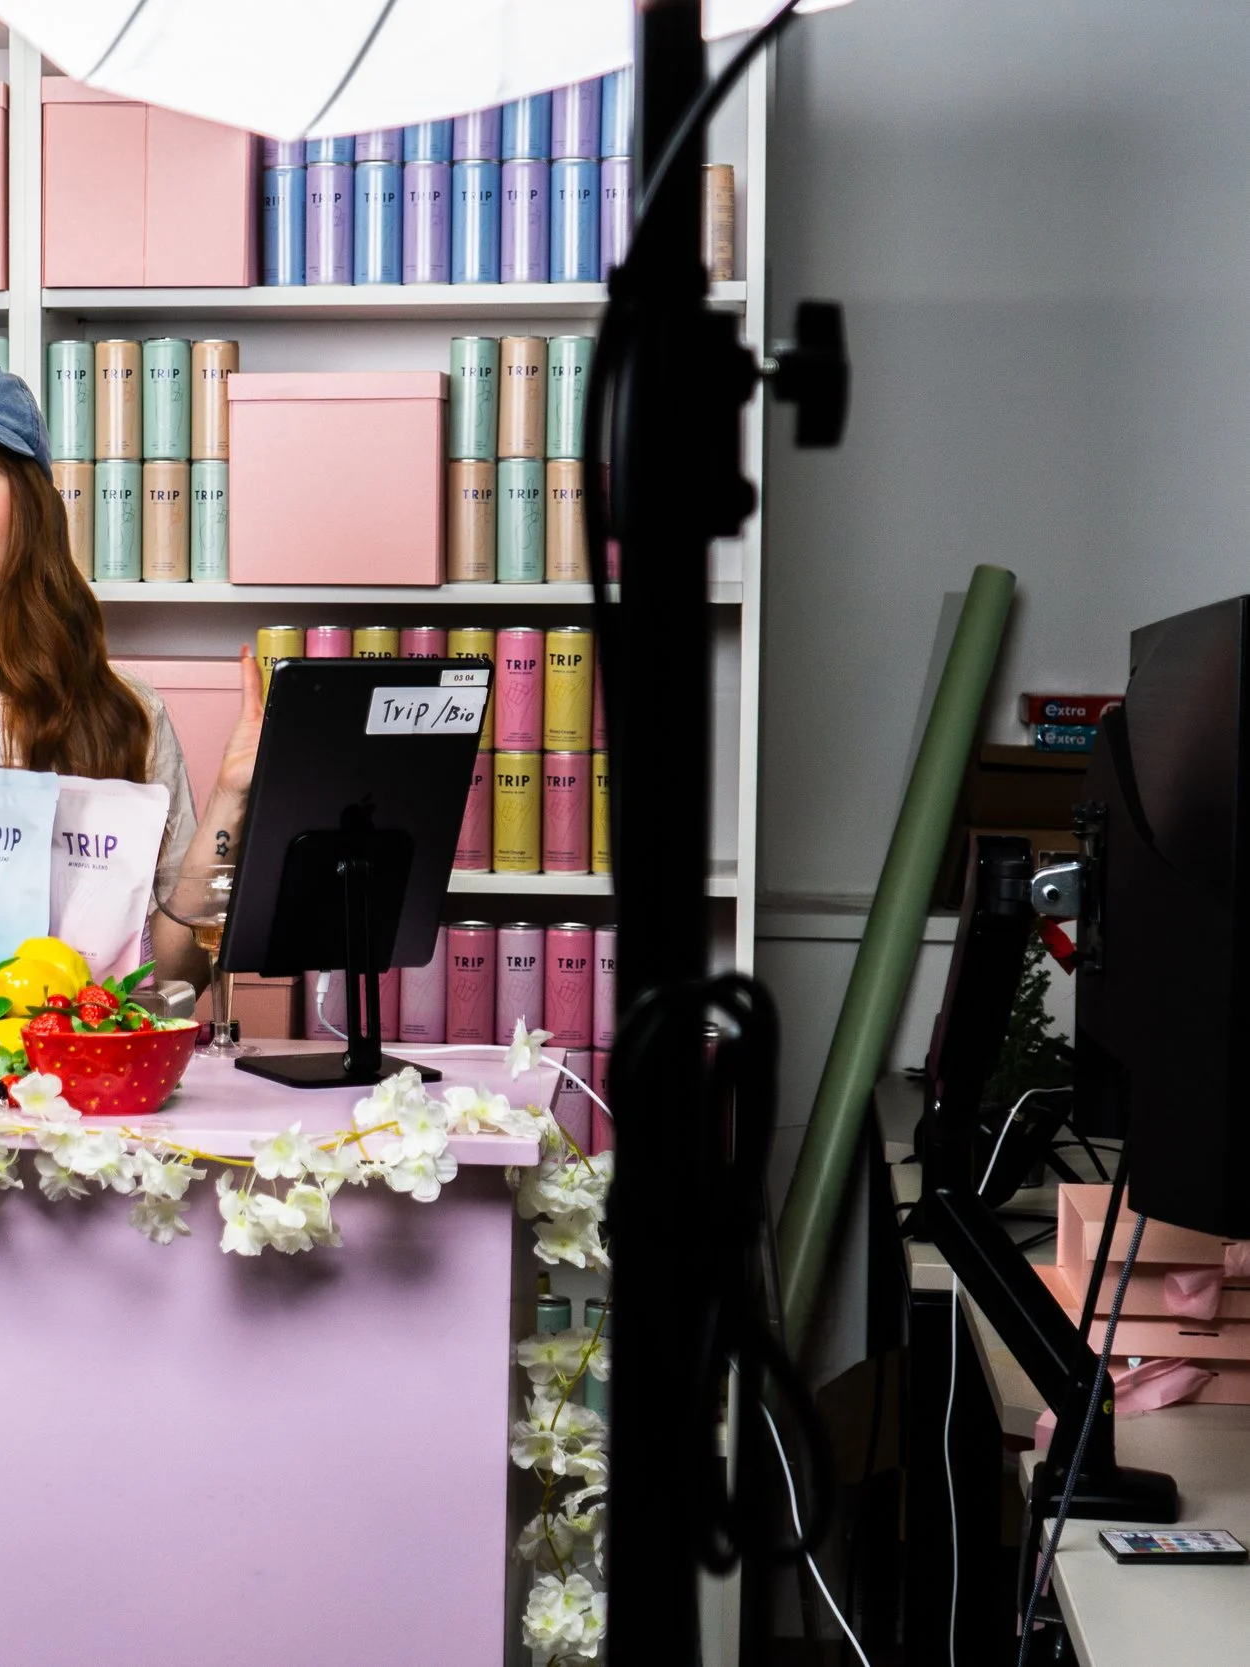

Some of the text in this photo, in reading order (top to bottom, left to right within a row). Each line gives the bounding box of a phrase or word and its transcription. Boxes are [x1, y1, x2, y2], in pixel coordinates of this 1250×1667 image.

[311, 192, 341, 204] TRIP
[364, 192, 395, 203] TRIP
[410, 191, 440, 203] TRIP
[461, 190, 492, 202] TRIP
[507, 189, 538, 201] TRIP
[559, 189, 590, 200] TRIP
[57, 370, 86, 380] TRIP
[103, 368, 132, 379] TRIP
[150, 368, 180, 379] TRIP
[461, 367, 492, 377] TRIP
[507, 366, 539, 376] TRIP
[552, 366, 582, 376] TRIP
[59, 489, 81, 499] RIP
[102, 489, 132, 500] TRIP
[150, 490, 180, 501] TRIP
[195, 490, 223, 500] TRIP
[462, 489, 492, 499] TRIP
[509, 489, 539, 499] TRIP
[552, 489, 583, 499] TRIP
[263, 656, 277, 667] TR
[506, 659, 536, 670] TRIP
[549, 653, 582, 666] TRIP
[1045, 704, 1086, 717] extra
[1045, 732, 1086, 745] extra
[498, 775, 530, 787] TRIP
[547, 776, 576, 787] TRIP
[62, 832, 118, 859] TRIP
[68, 861, 90, 869] MINDFUL
[454, 956, 485, 968] TRIP
[507, 956, 536, 968] TRIP
[557, 958, 587, 970] TRIP
[601, 958, 615, 970] TR
